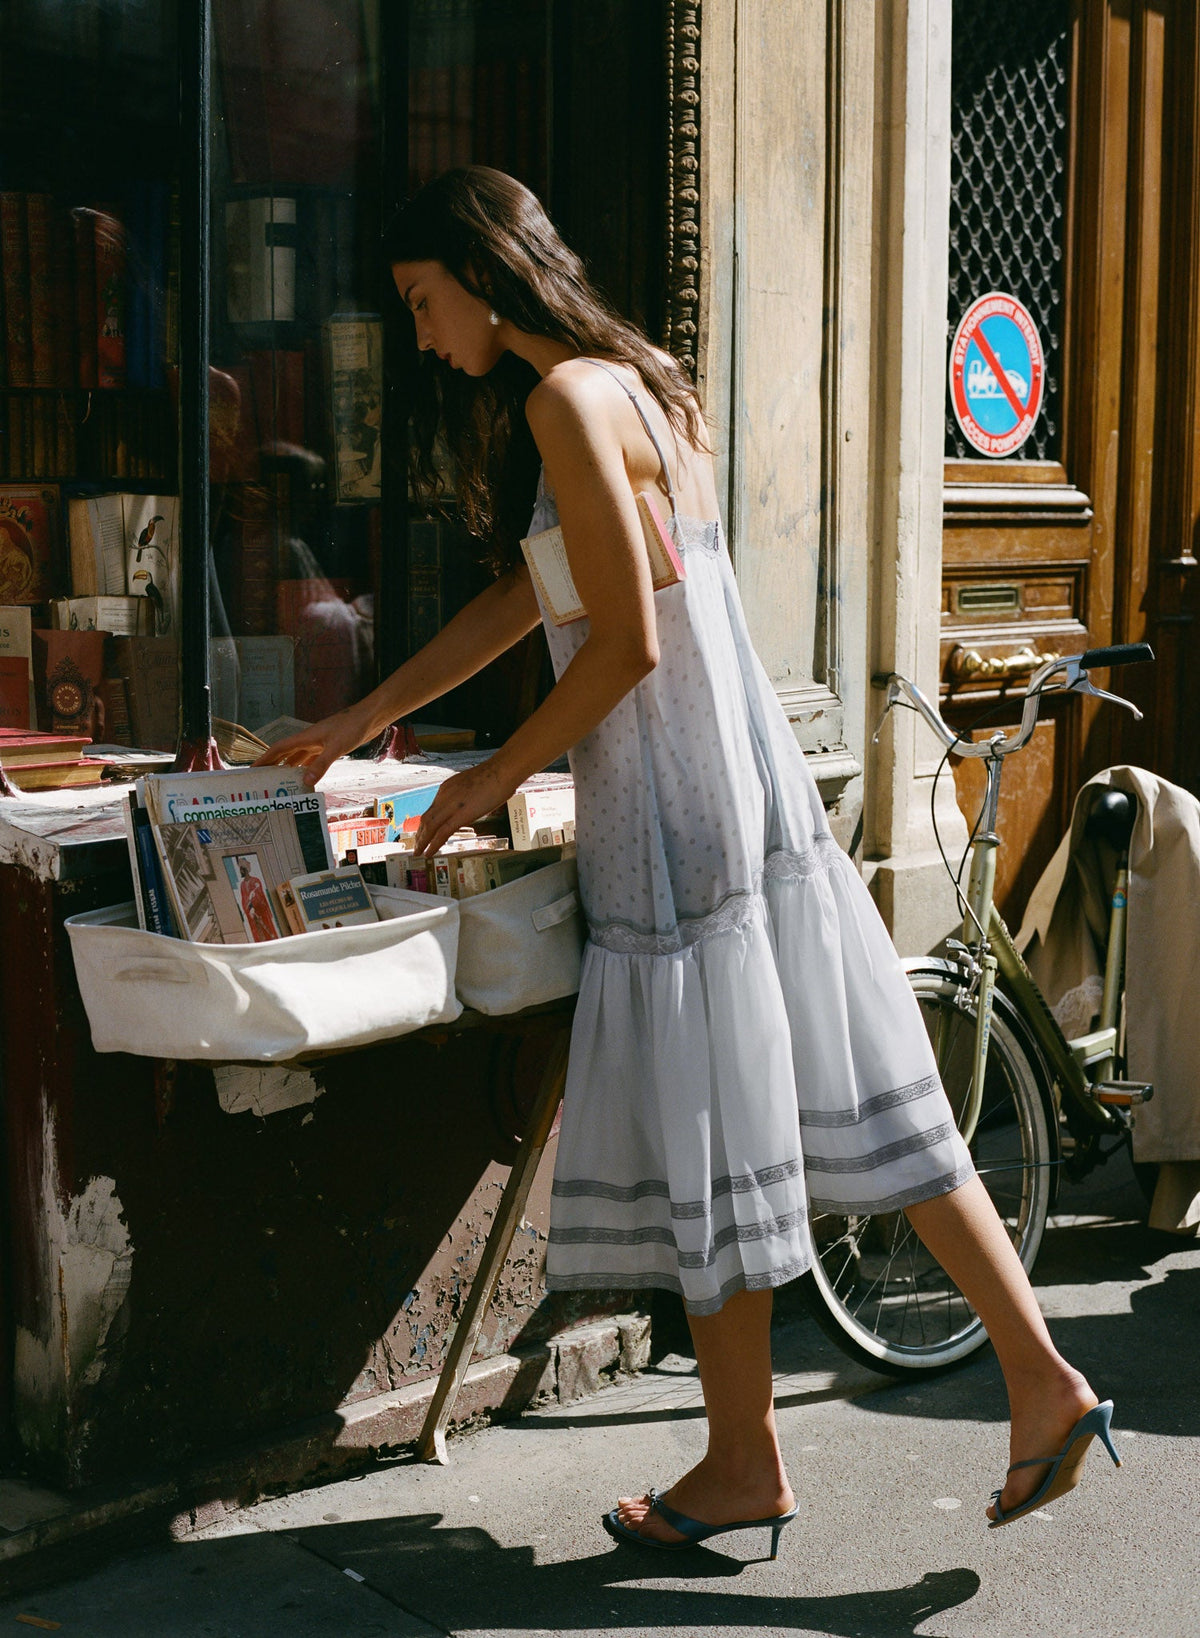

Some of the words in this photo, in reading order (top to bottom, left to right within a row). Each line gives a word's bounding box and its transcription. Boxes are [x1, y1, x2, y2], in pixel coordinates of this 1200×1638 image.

[954, 300, 1016, 366] STATIONNEMENT
[1013, 309, 1040, 366] INTERDIT
[300, 884, 340, 900] Rosamunde
[339, 881, 361, 891] Pilcher
